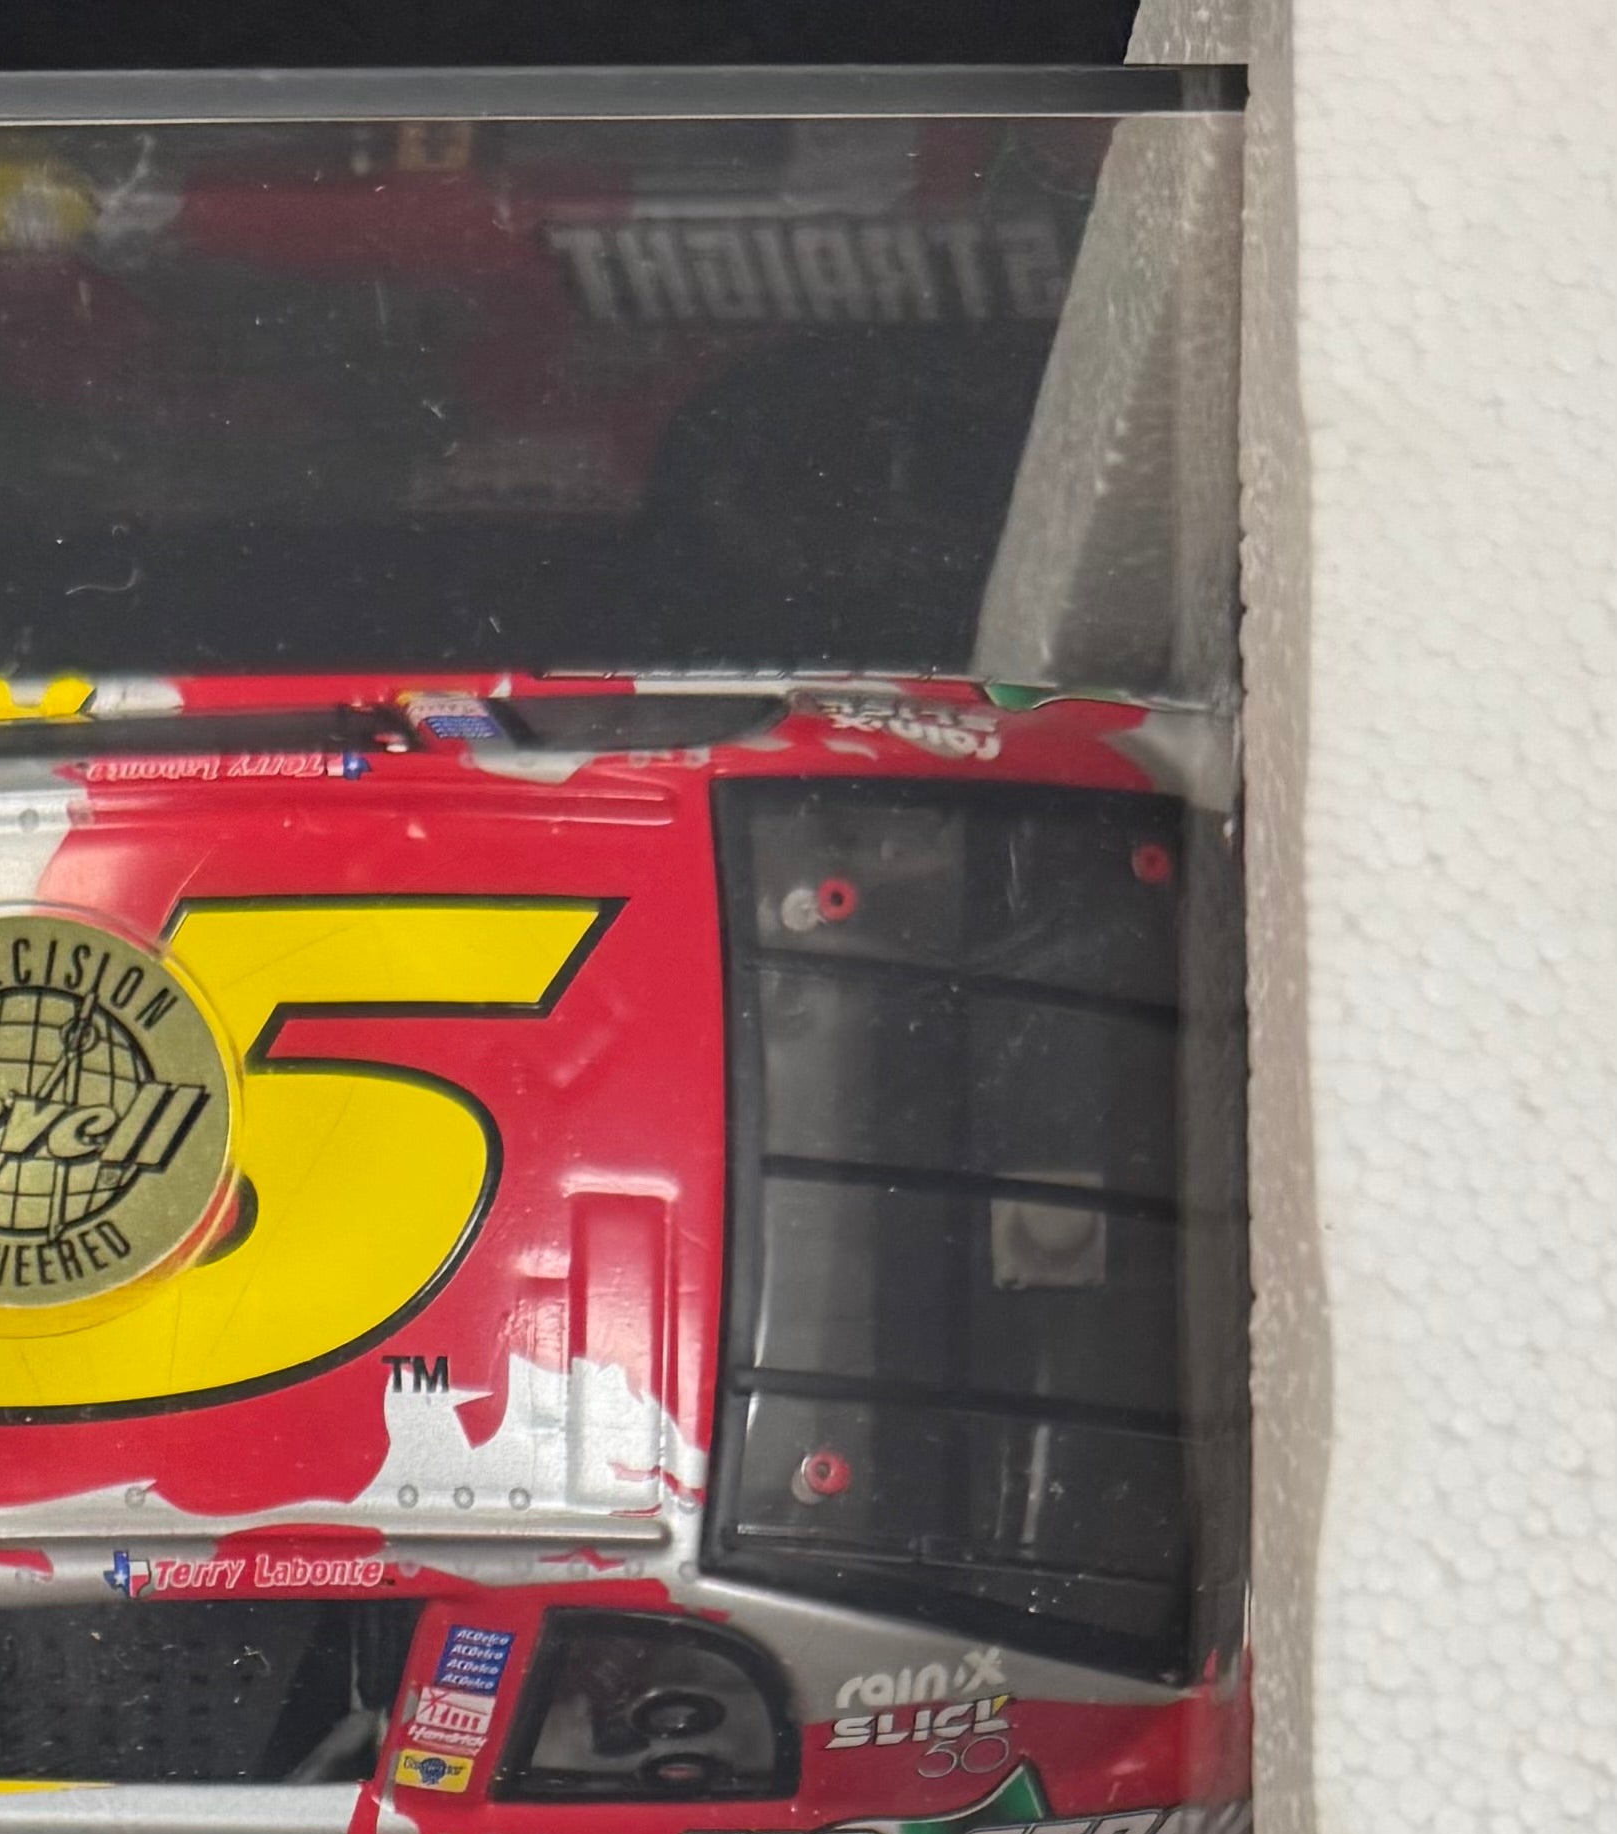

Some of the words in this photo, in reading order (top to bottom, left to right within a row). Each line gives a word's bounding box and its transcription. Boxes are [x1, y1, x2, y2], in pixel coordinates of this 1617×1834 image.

[383, 1355, 450, 1393] TM
[153, 1555, 247, 1590] Terry
[253, 1553, 385, 1588] Labonte
[917, 1733, 1010, 1779] 50
